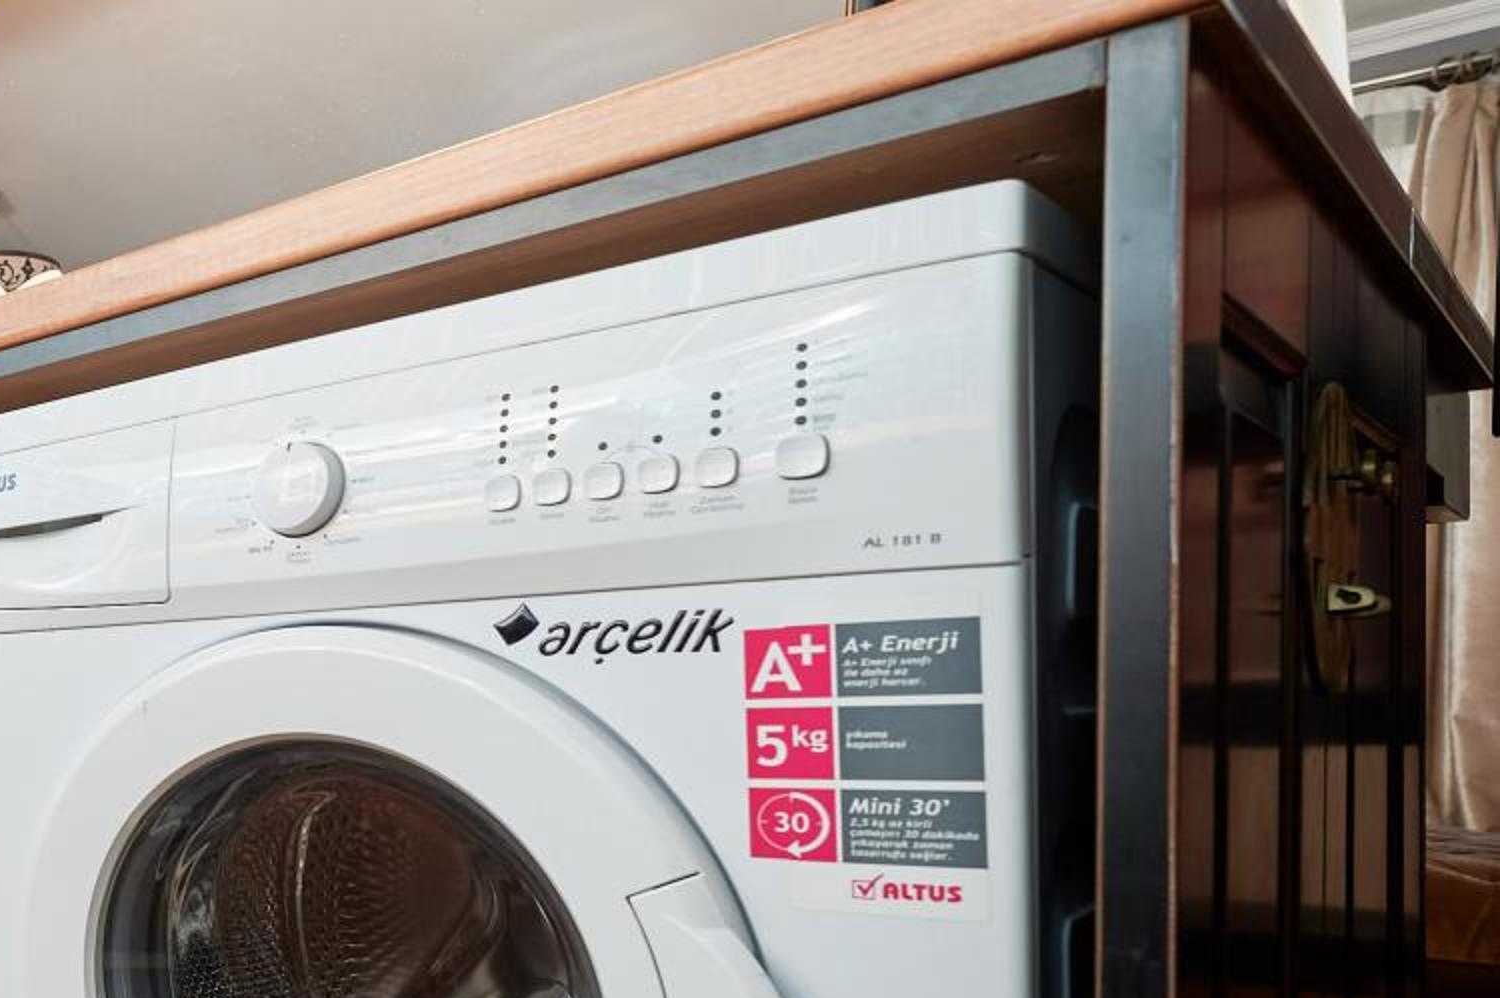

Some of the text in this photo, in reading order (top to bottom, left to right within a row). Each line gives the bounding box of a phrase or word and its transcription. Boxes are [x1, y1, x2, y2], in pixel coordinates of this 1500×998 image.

[862, 537, 885, 549] AL
[538, 608, 735, 665] arçelik
[842, 630, 960, 654] A+ Enerji
[751, 633, 826, 693] A+
[756, 724, 828, 767] 5 kg
[849, 798, 901, 815] Mini
[774, 811, 810, 833] 30
[882, 882, 963, 903] ALTUS
